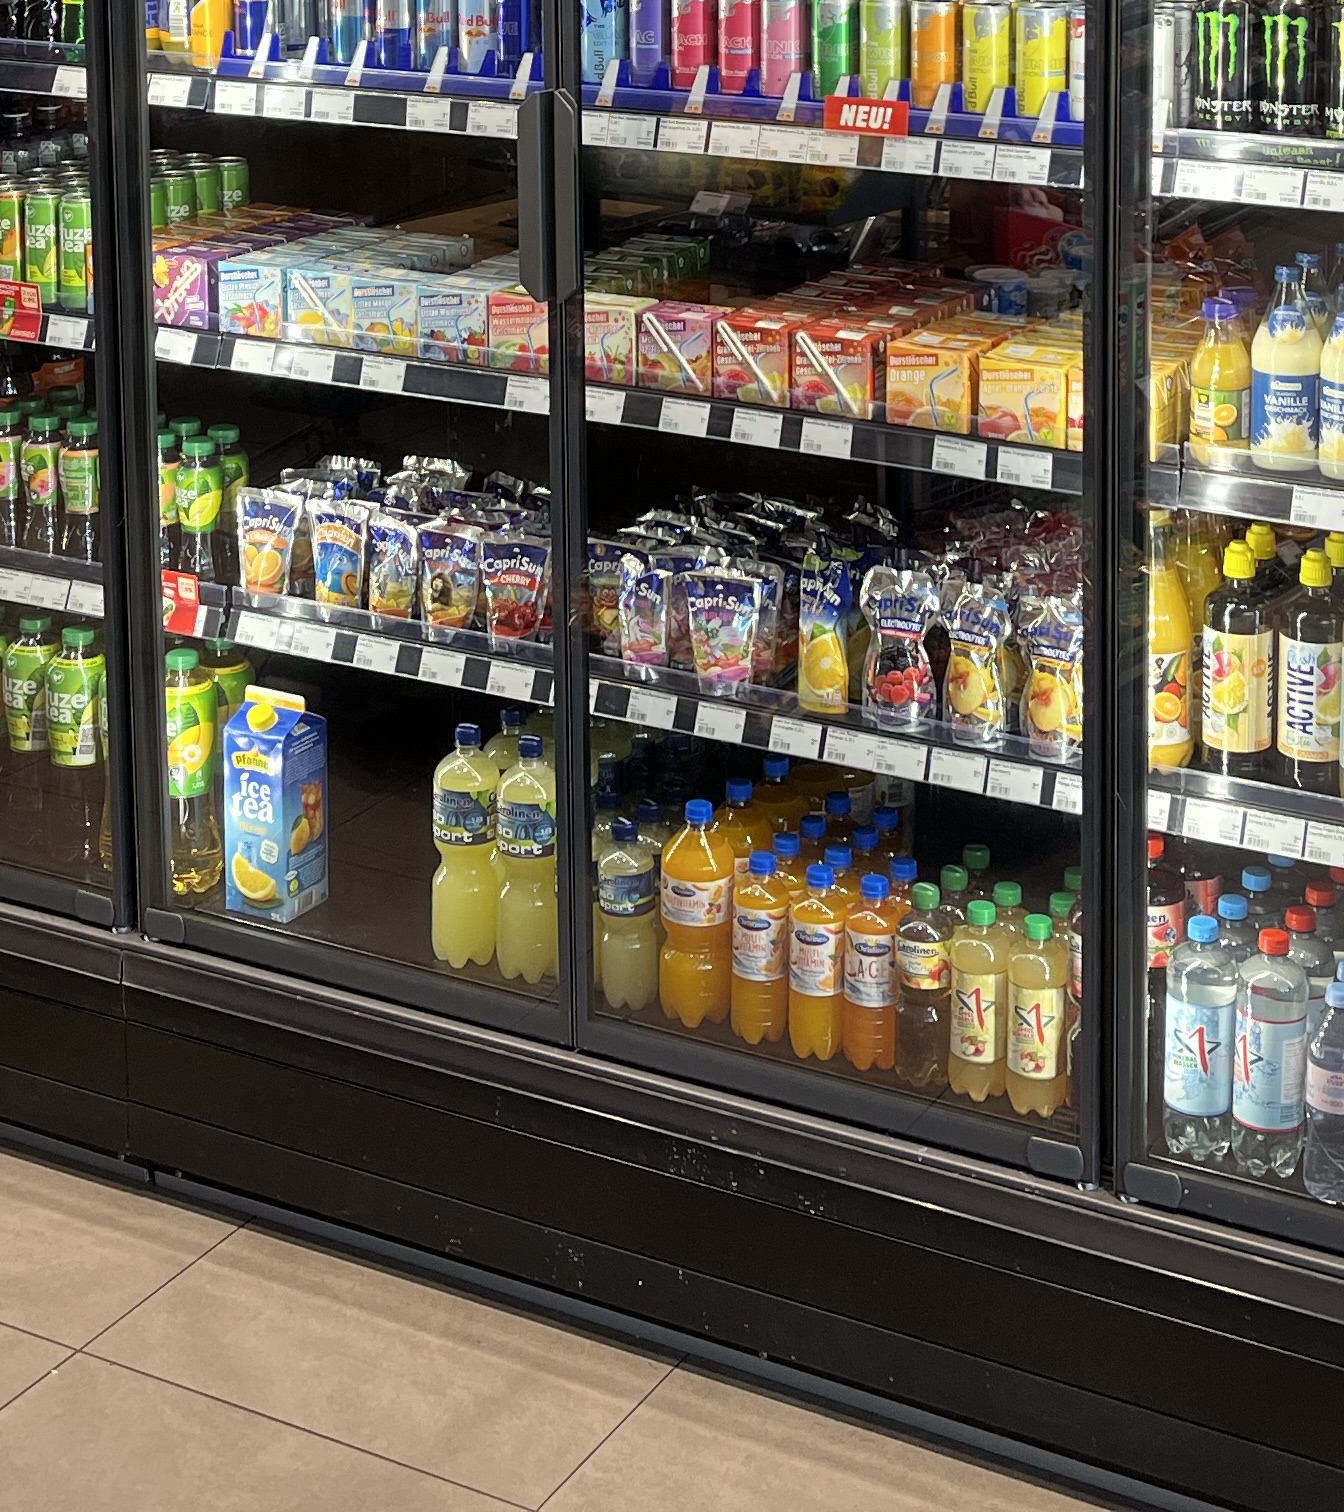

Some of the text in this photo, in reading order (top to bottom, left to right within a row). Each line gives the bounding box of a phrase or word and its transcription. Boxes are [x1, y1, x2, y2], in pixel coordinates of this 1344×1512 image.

[840, 103, 893, 130] NEU!
[889, 367, 926, 382] Orange
[1264, 394, 1308, 407] VANILLE
[500, 573, 531, 586] CHERRY
[1286, 660, 1315, 736] ACTIVE
[239, 772, 271, 802] ice
[231, 791, 274, 824] tea
